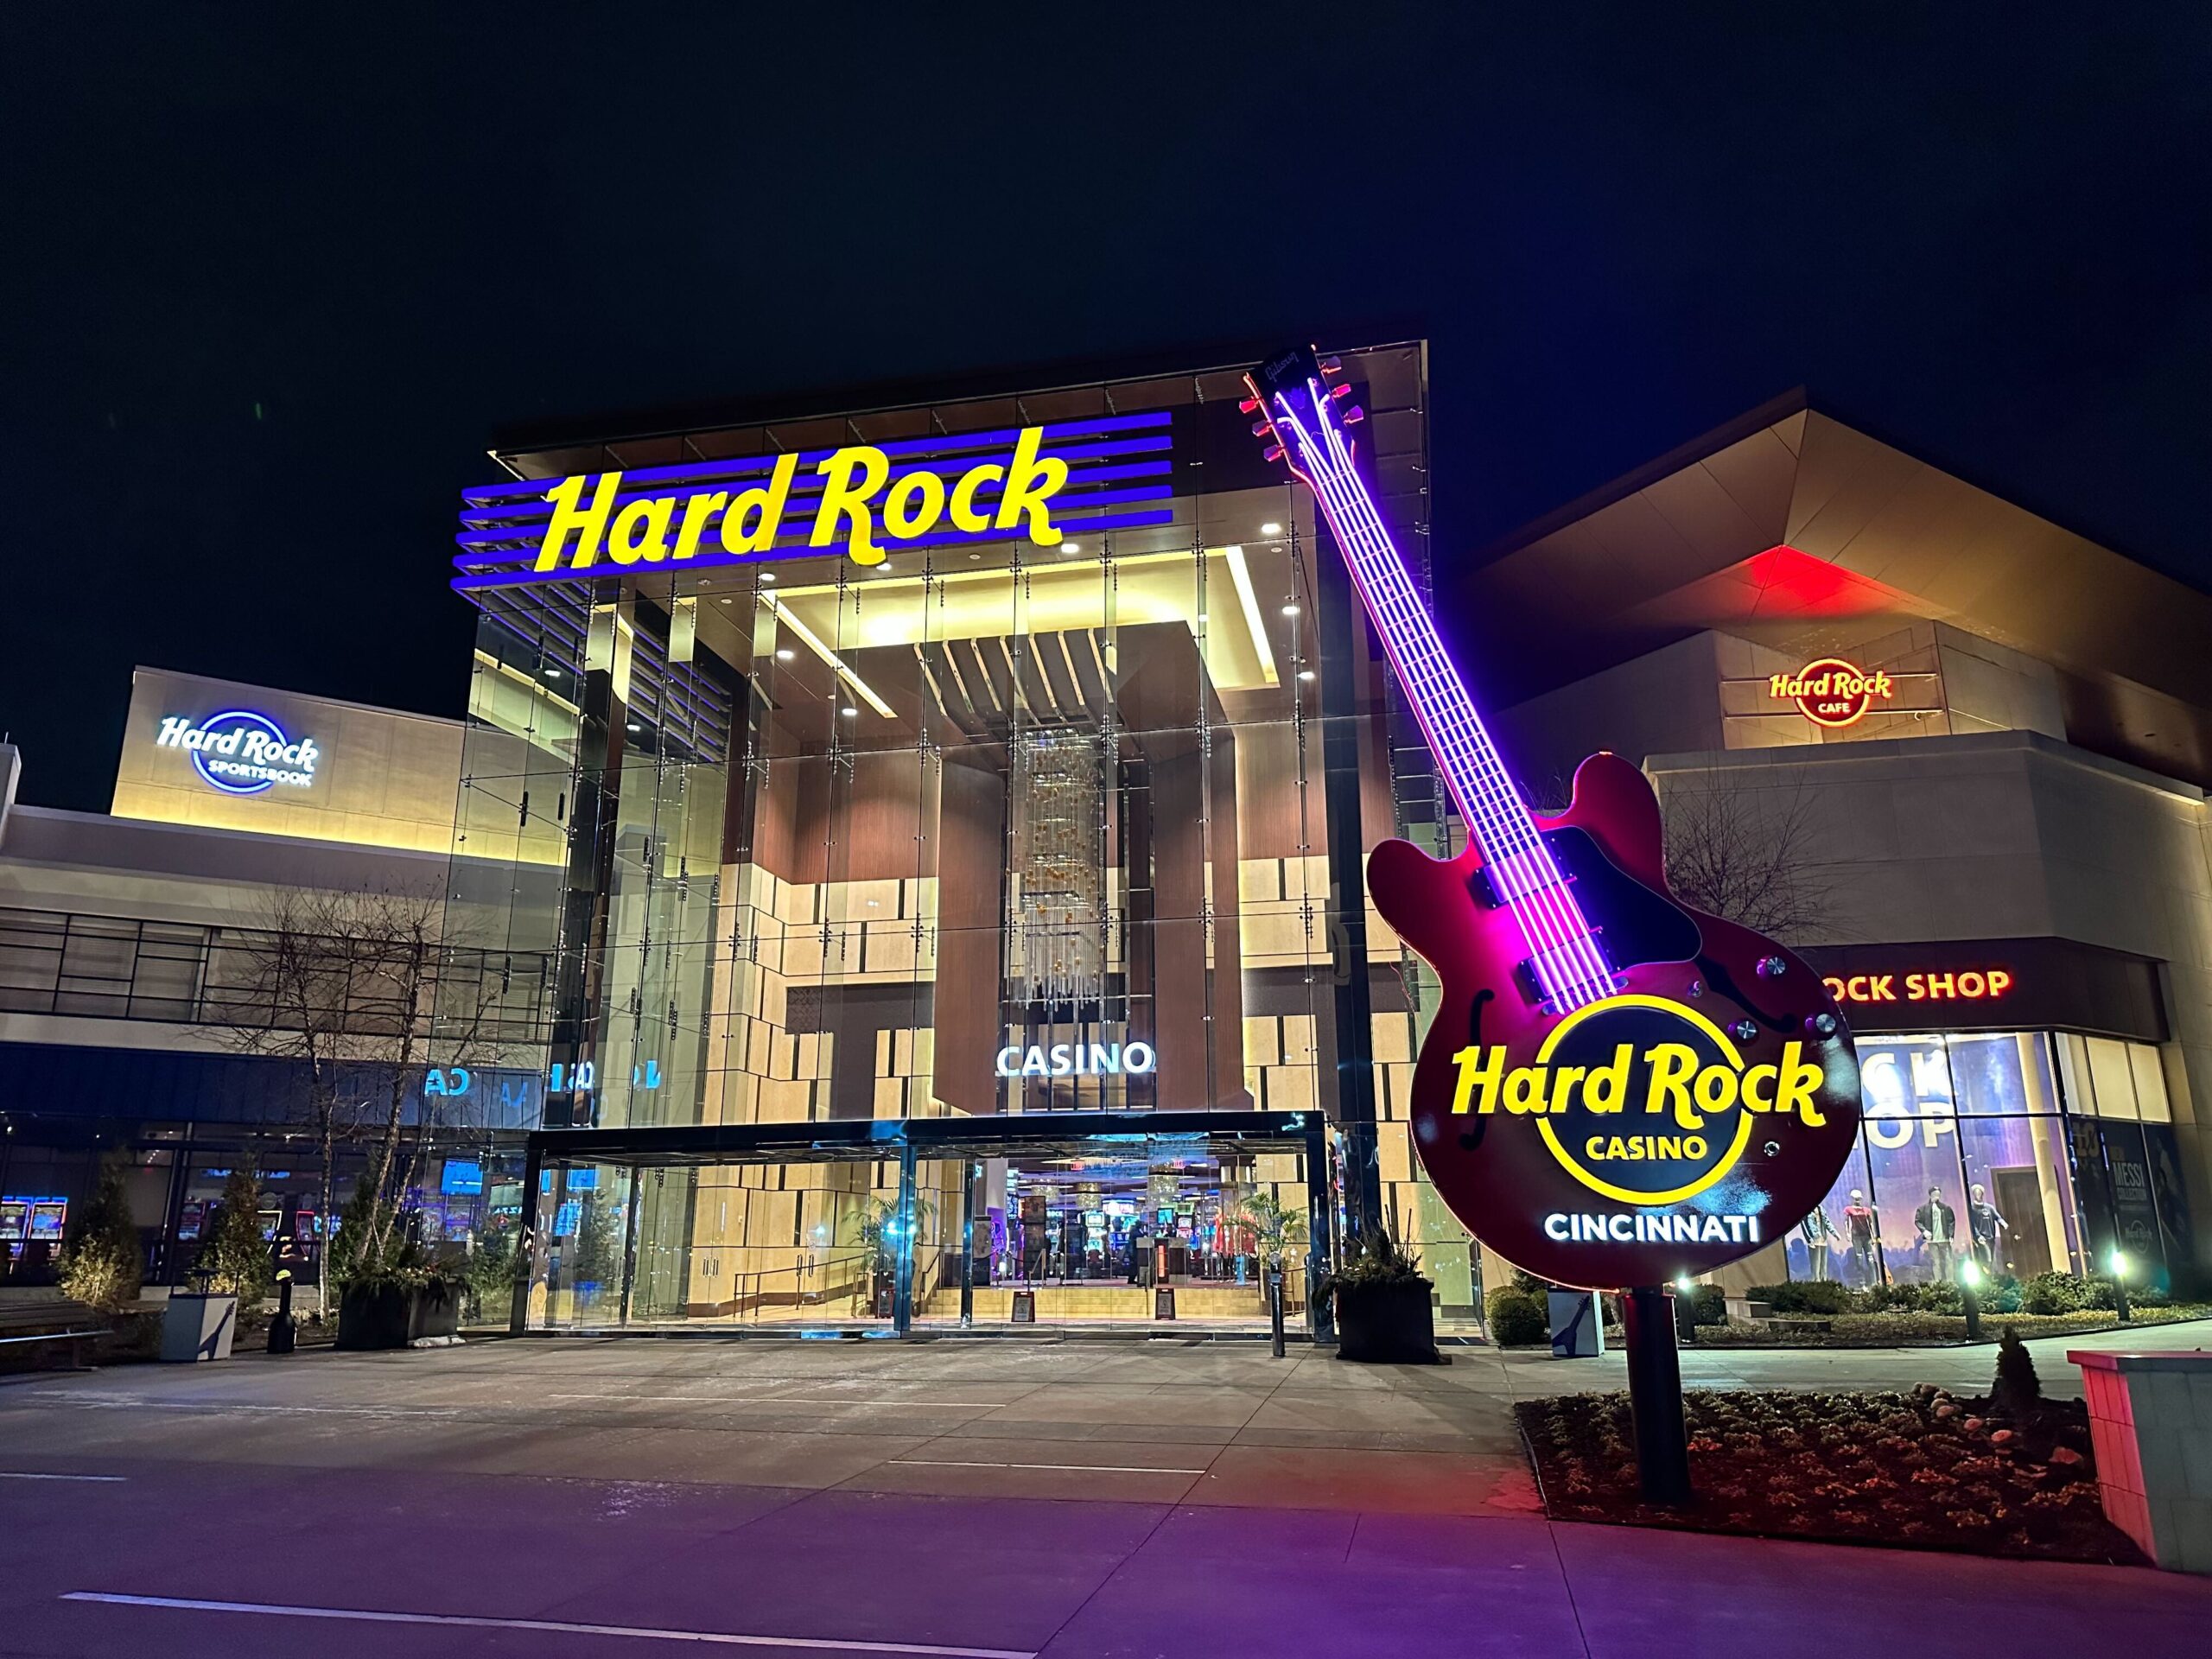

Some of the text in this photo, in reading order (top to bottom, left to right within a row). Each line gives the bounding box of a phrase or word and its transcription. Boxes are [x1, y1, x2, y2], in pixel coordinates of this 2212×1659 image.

[1266, 352, 1300, 382] Gibson
[534, 426, 1068, 572] Hard Rock
[1769, 671, 1892, 699] Hard Rock
[1817, 702, 1851, 714] CAFE
[156, 717, 319, 772] Hard Rock
[208, 760, 312, 786] SPORTSBOOK
[1822, 970, 2012, 1001] OCK SHOP
[995, 1041, 1156, 1077] CASINO
[1451, 1041, 1826, 1130] Hard Rock
[1586, 1136, 1707, 1161] CASINO
[2113, 1163, 2145, 1186] MESSI
[1544, 1213, 1759, 1243] CINCINNATI
